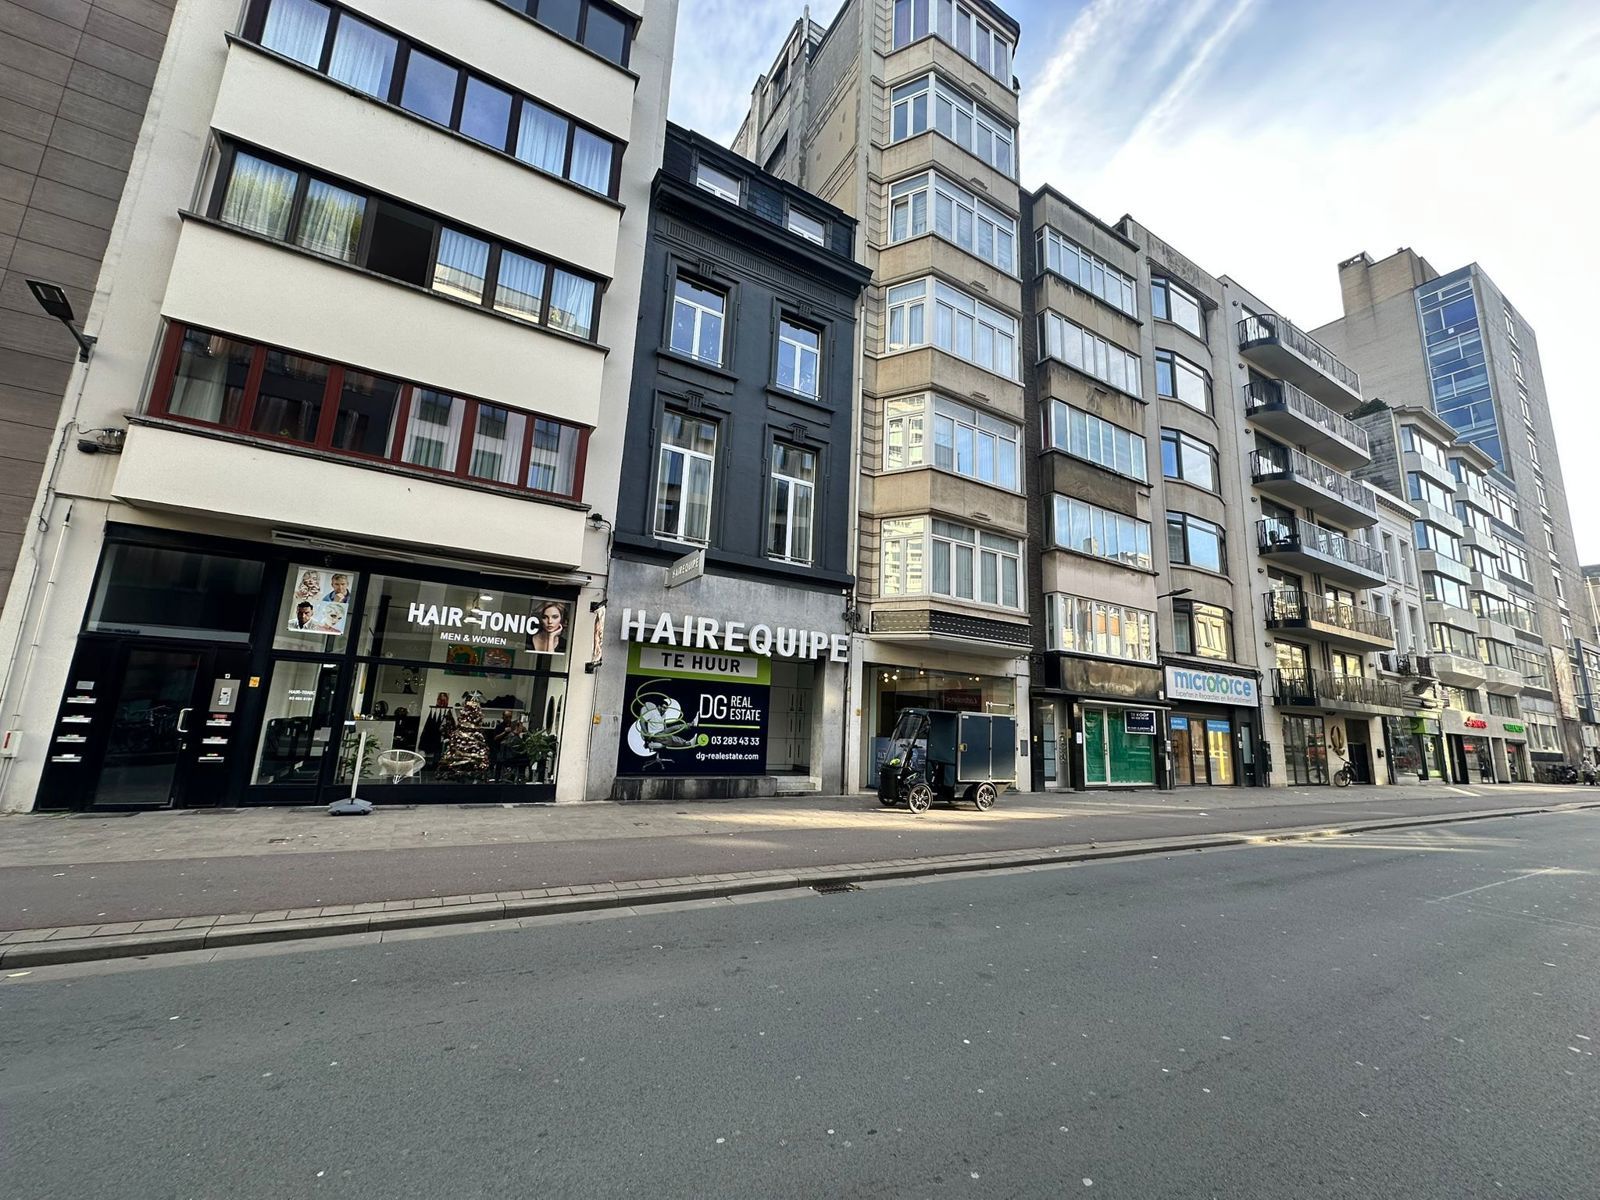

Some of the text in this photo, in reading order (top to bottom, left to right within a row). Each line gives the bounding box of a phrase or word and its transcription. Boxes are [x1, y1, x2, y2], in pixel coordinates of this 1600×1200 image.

[440, 631, 507, 646] MEN & WOMEN
[620, 608, 849, 663] HAIREQUIPE
[661, 652, 741, 673] TE HUUR
[1174, 671, 1252, 697] microforce
[700, 694, 728, 720] DG
[730, 695, 753, 708] REAL
[730, 708, 761, 721] ESTATE
[711, 736, 760, 746] 03 283 43 33
[696, 751, 759, 762] dg-realestate.com
